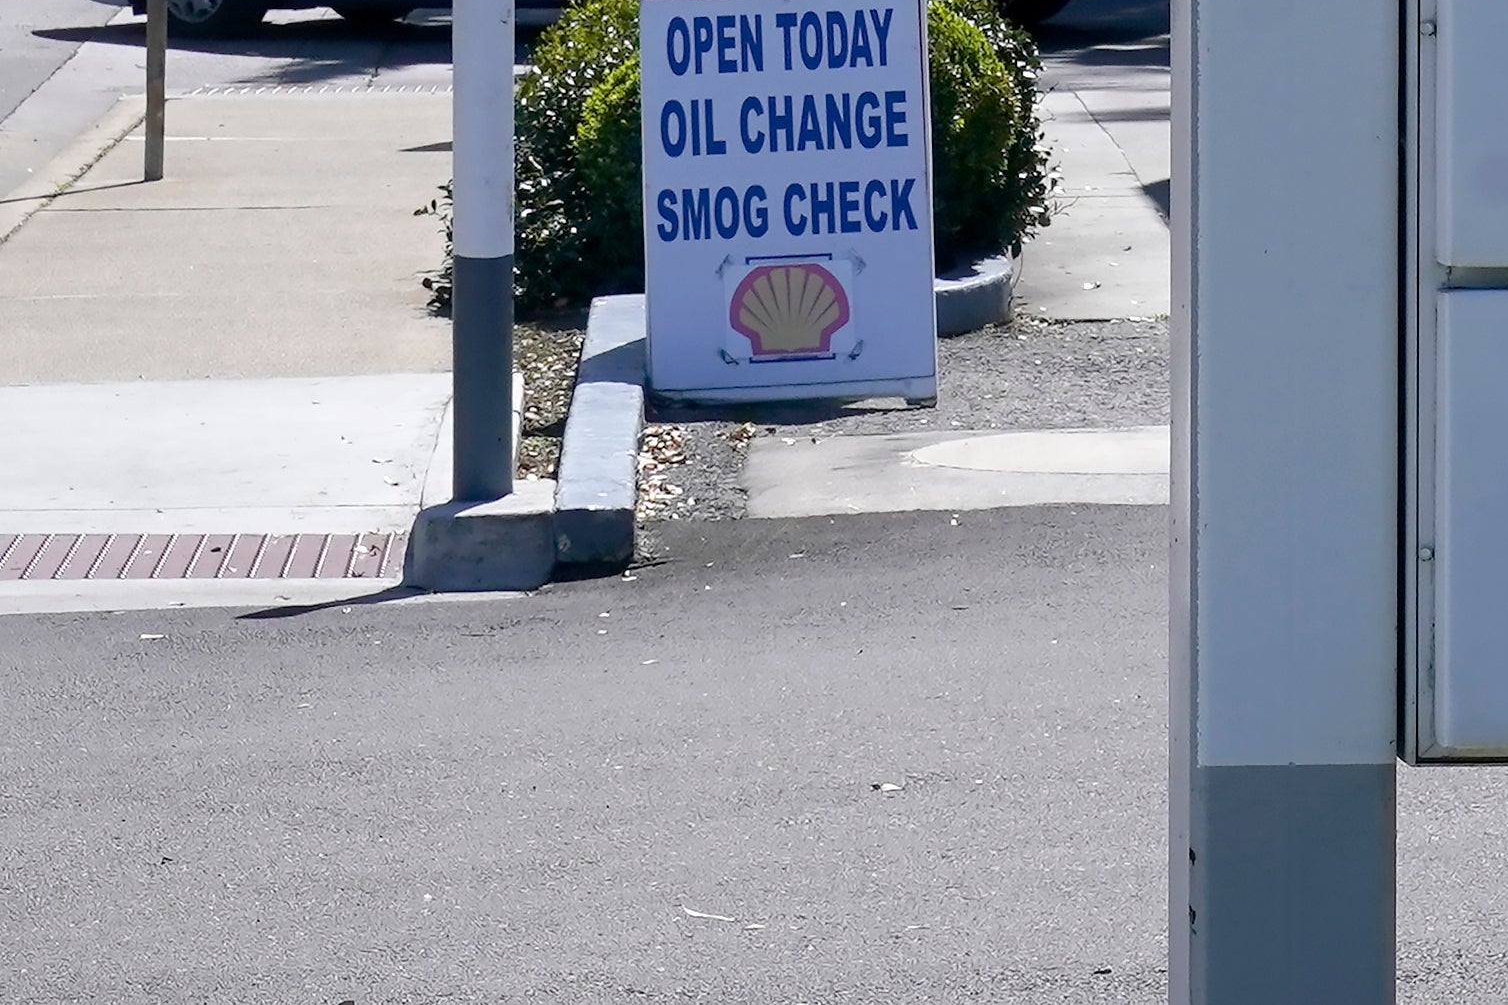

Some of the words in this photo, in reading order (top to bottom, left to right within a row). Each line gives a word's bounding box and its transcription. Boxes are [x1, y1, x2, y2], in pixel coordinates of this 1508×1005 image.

[666, 14, 764, 76] OPEN
[775, 7, 894, 71] TODAY
[660, 98, 727, 157] OIL
[740, 90, 909, 154] CHANGE
[657, 184, 769, 243] SMOG
[783, 178, 919, 237] CHECK
